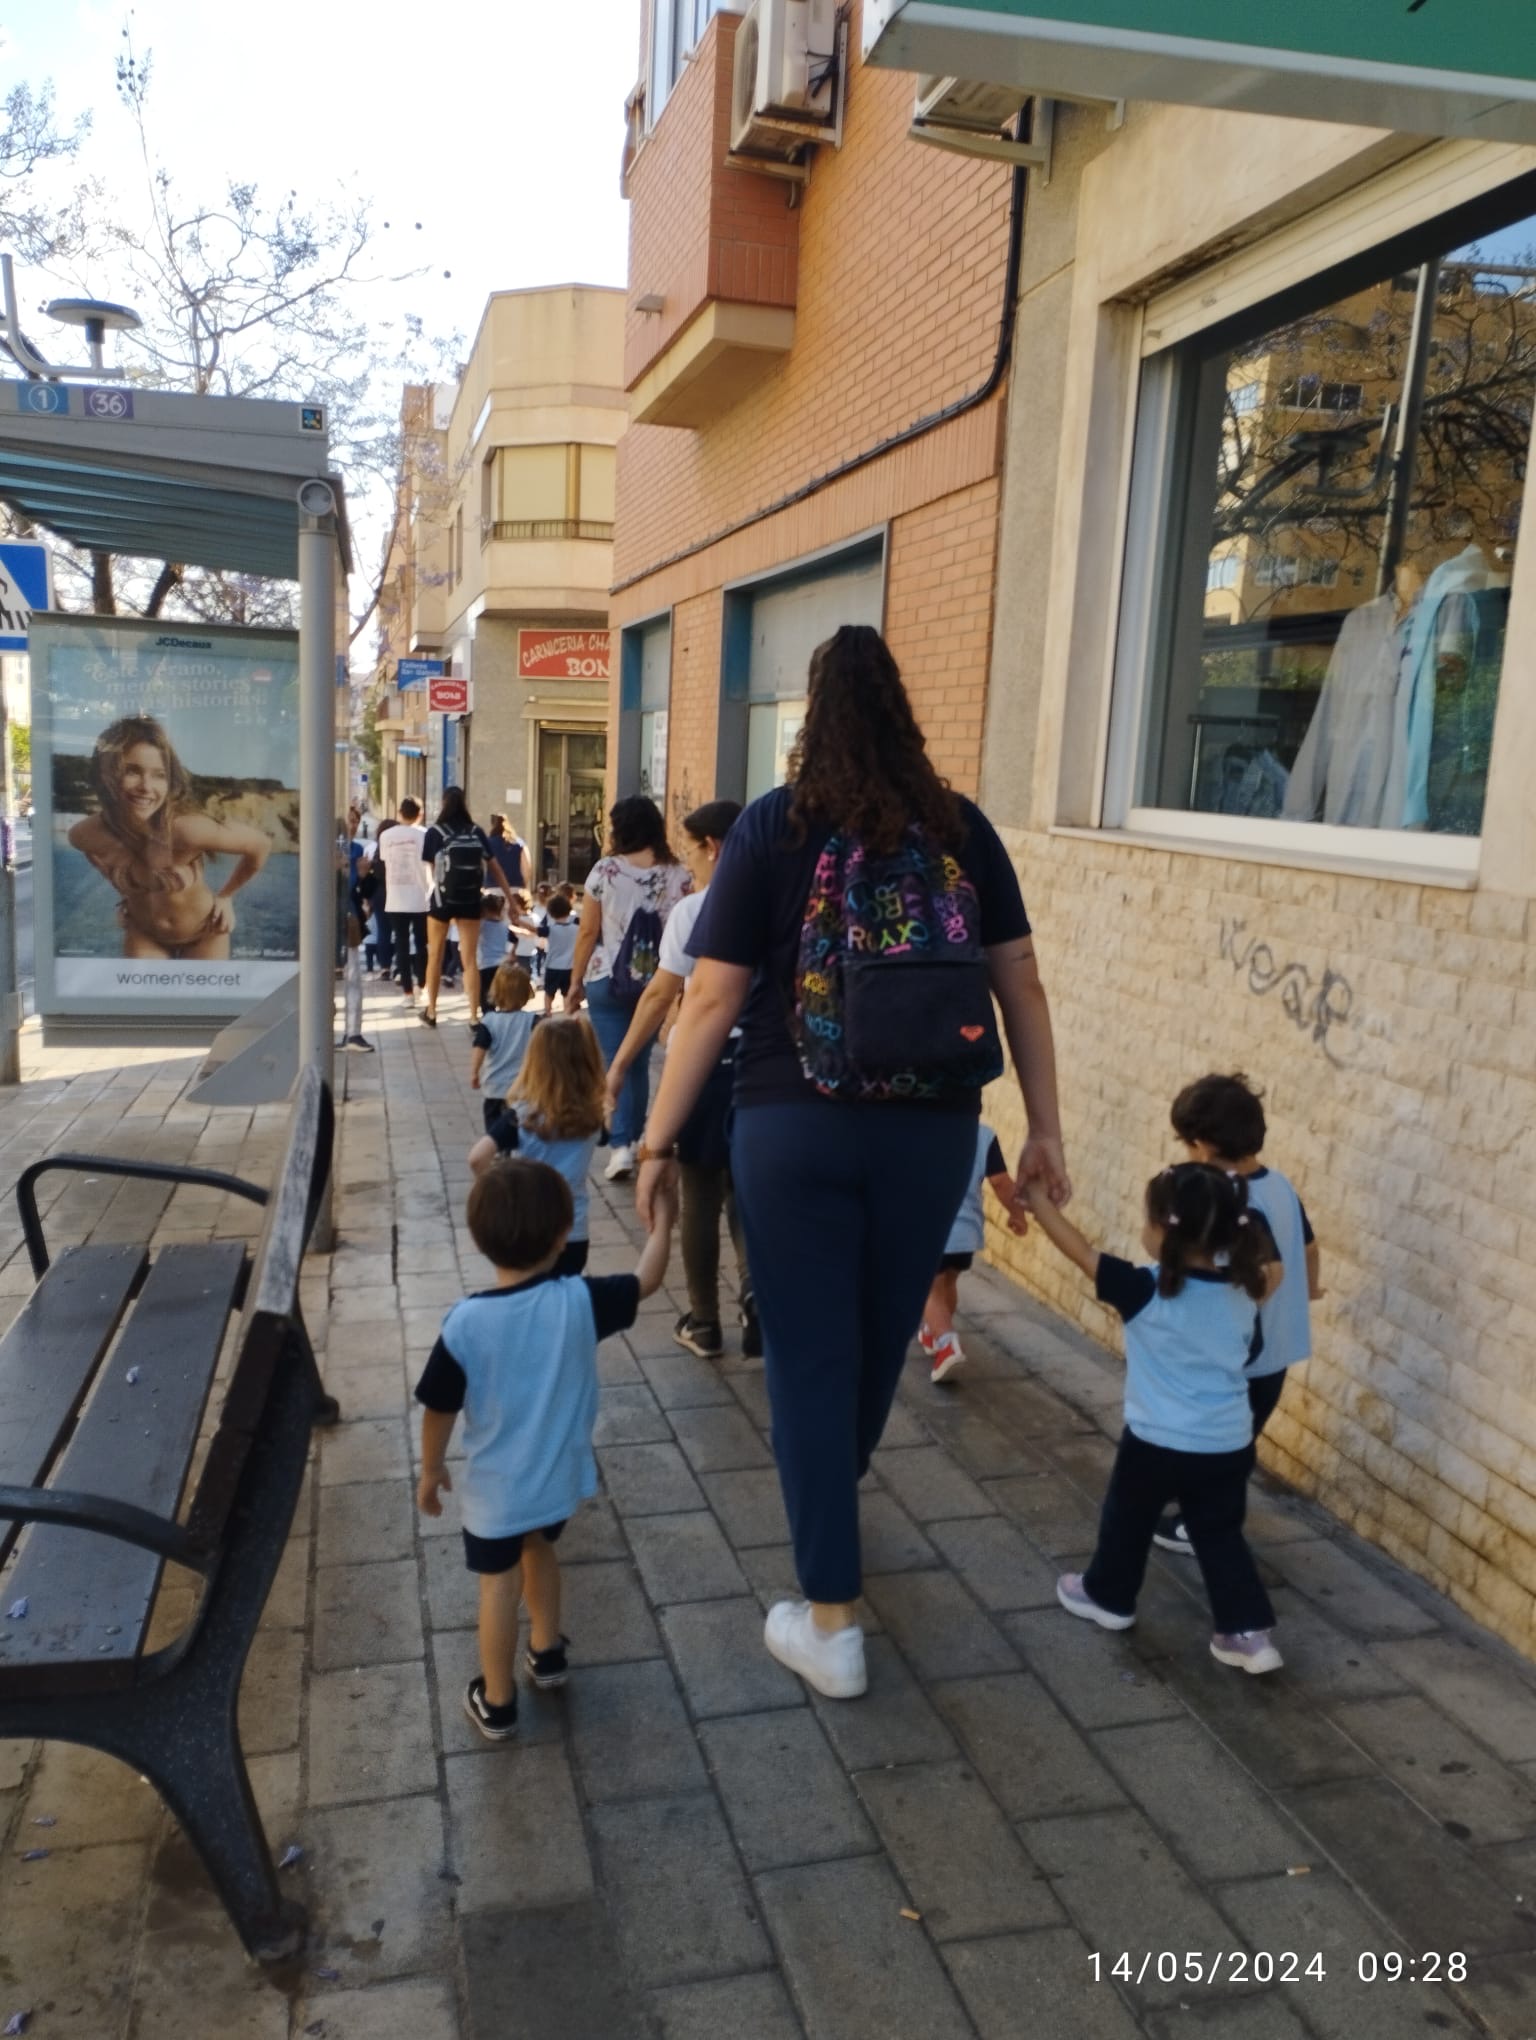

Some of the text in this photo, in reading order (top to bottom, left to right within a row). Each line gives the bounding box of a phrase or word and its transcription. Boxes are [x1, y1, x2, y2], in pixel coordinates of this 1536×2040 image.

[94, 393, 123, 414] 36
[155, 636, 212, 649] JCDecaux
[522, 634, 585, 668] CARNICERIA
[116, 972, 241, 986] women'secret
